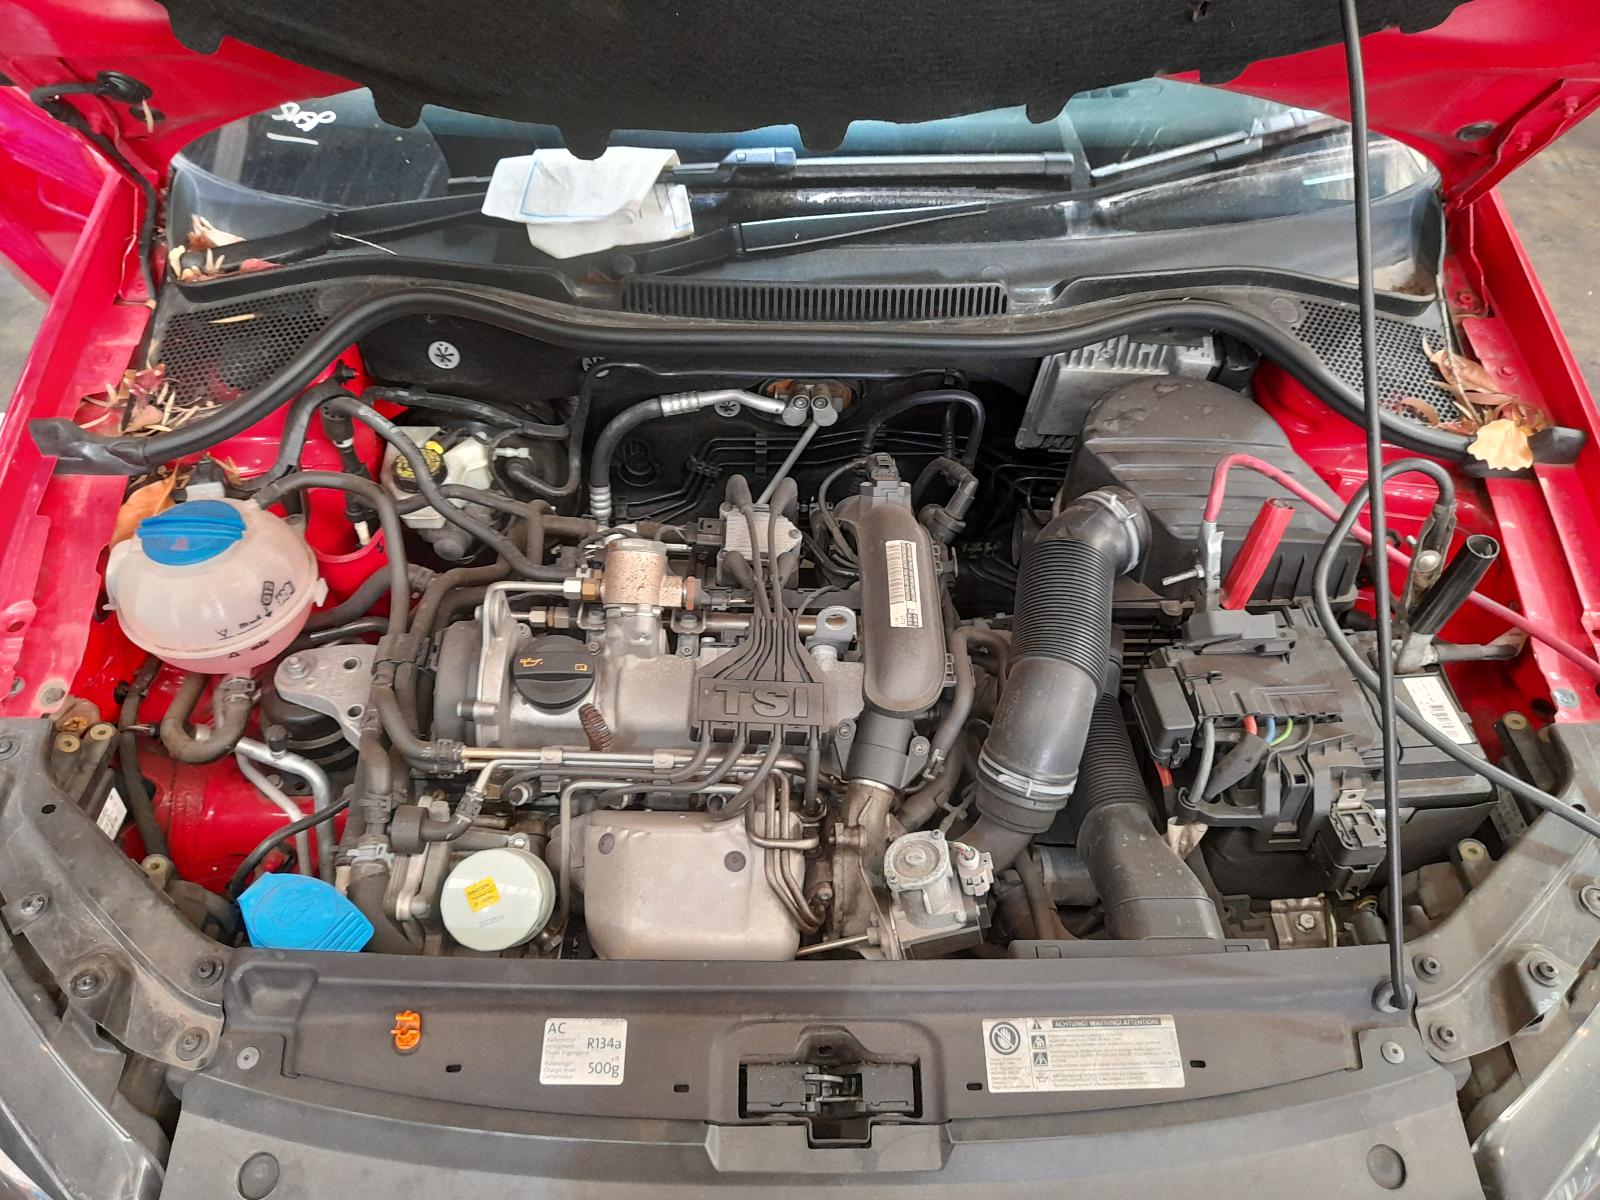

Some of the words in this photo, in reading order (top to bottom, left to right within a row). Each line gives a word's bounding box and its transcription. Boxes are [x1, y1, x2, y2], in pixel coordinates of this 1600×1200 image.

[714, 684, 808, 718] TSI
[547, 1022, 566, 1034] AC
[587, 1037, 622, 1049] R134a
[588, 1061, 620, 1078] 500g
